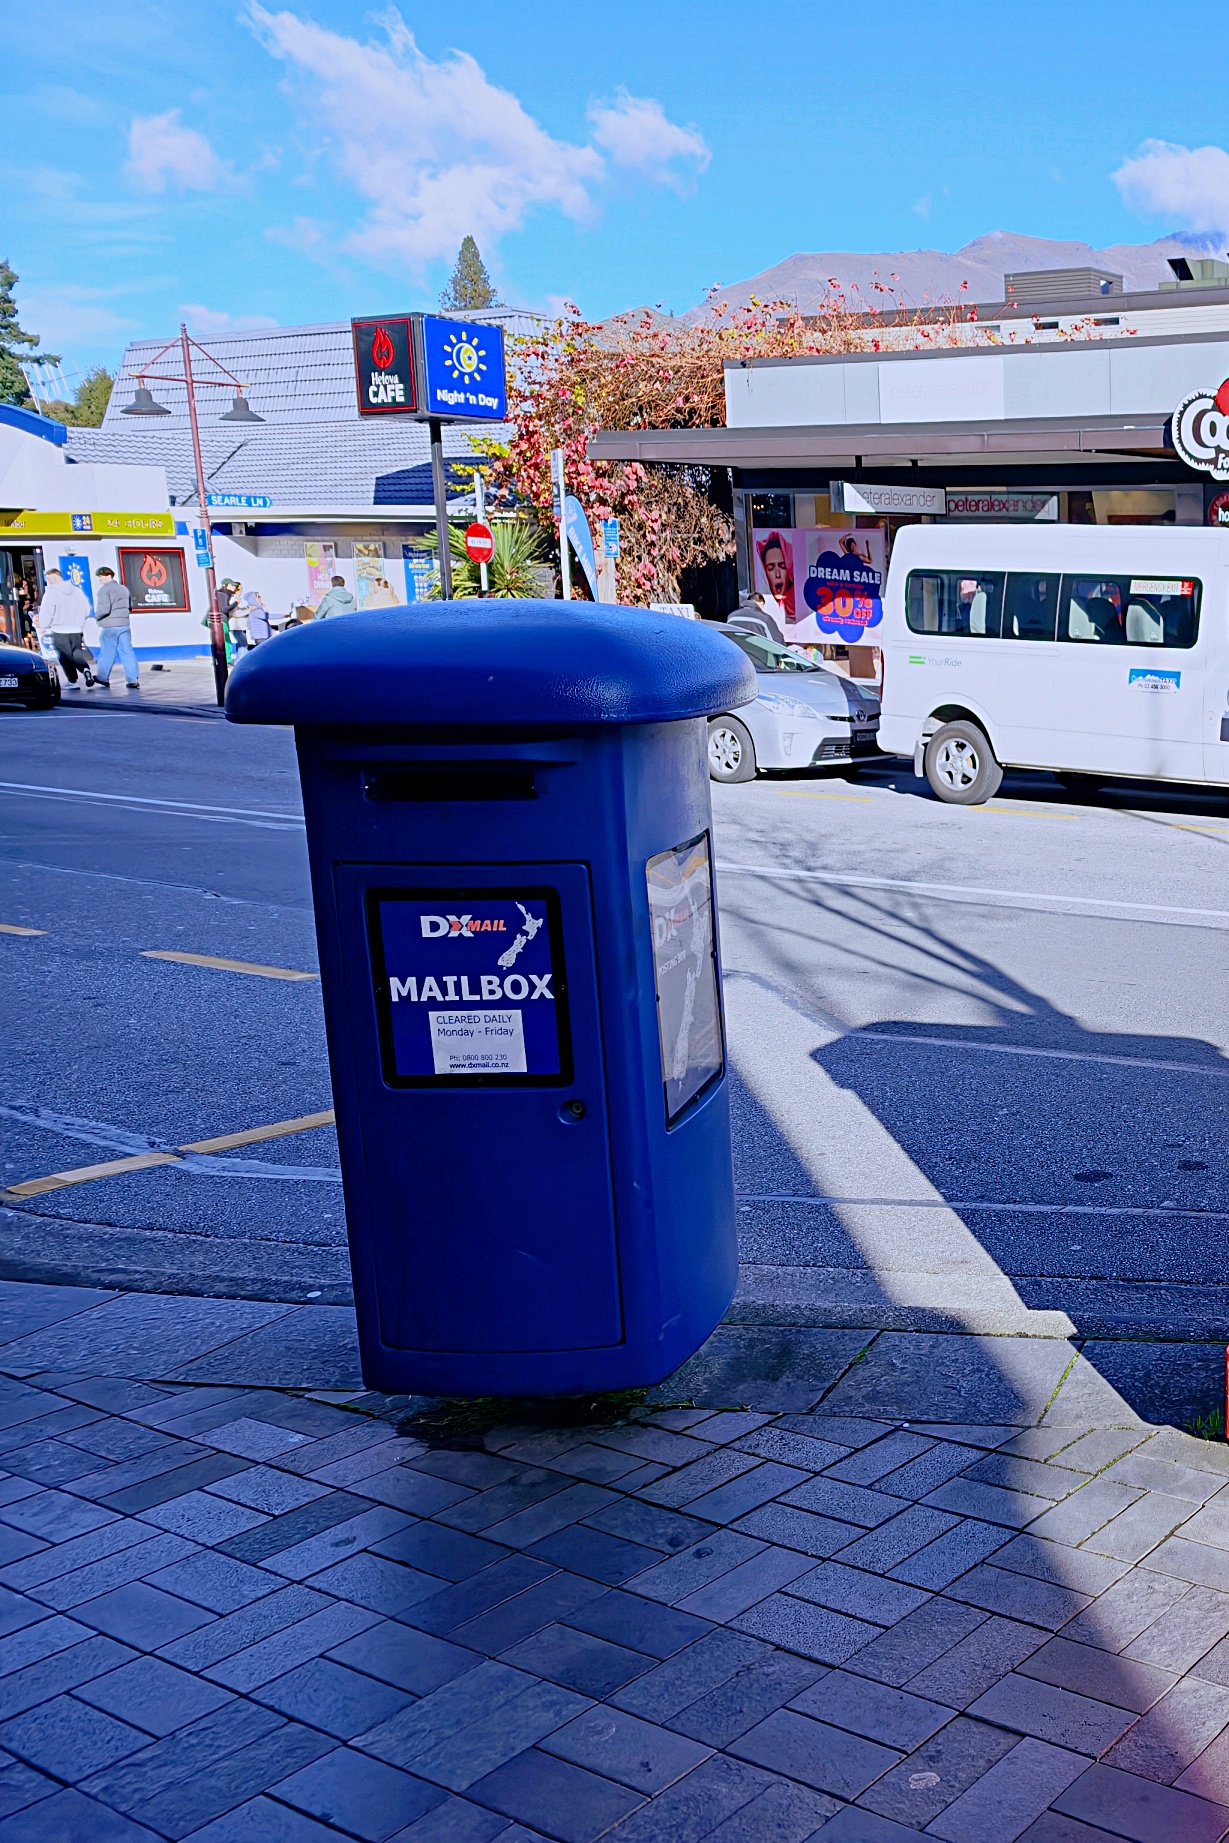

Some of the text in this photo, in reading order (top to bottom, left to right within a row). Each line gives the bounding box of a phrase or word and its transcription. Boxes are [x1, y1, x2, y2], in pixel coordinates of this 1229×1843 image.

[371, 371, 399, 385] Helova
[368, 384, 405, 404] CAFE
[436, 389, 465, 405] Night
[477, 394, 499, 410] Day
[211, 496, 264, 506] SEARLE LN
[854, 489, 937, 509] peteralexander
[107, 519, 164, 528] 24 HOURS
[809, 567, 881, 584] DREAM SALE
[1132, 581, 1166, 592] EMERGENCY
[1166, 583, 1179, 592] EXIT
[660, 607, 690, 618] TAXI
[389, 974, 555, 1002] MAILBOX
[436, 1014, 513, 1025] CLEARED DAILY
[437, 1028, 475, 1038] Monday
[484, 1027, 514, 1037] Friday
